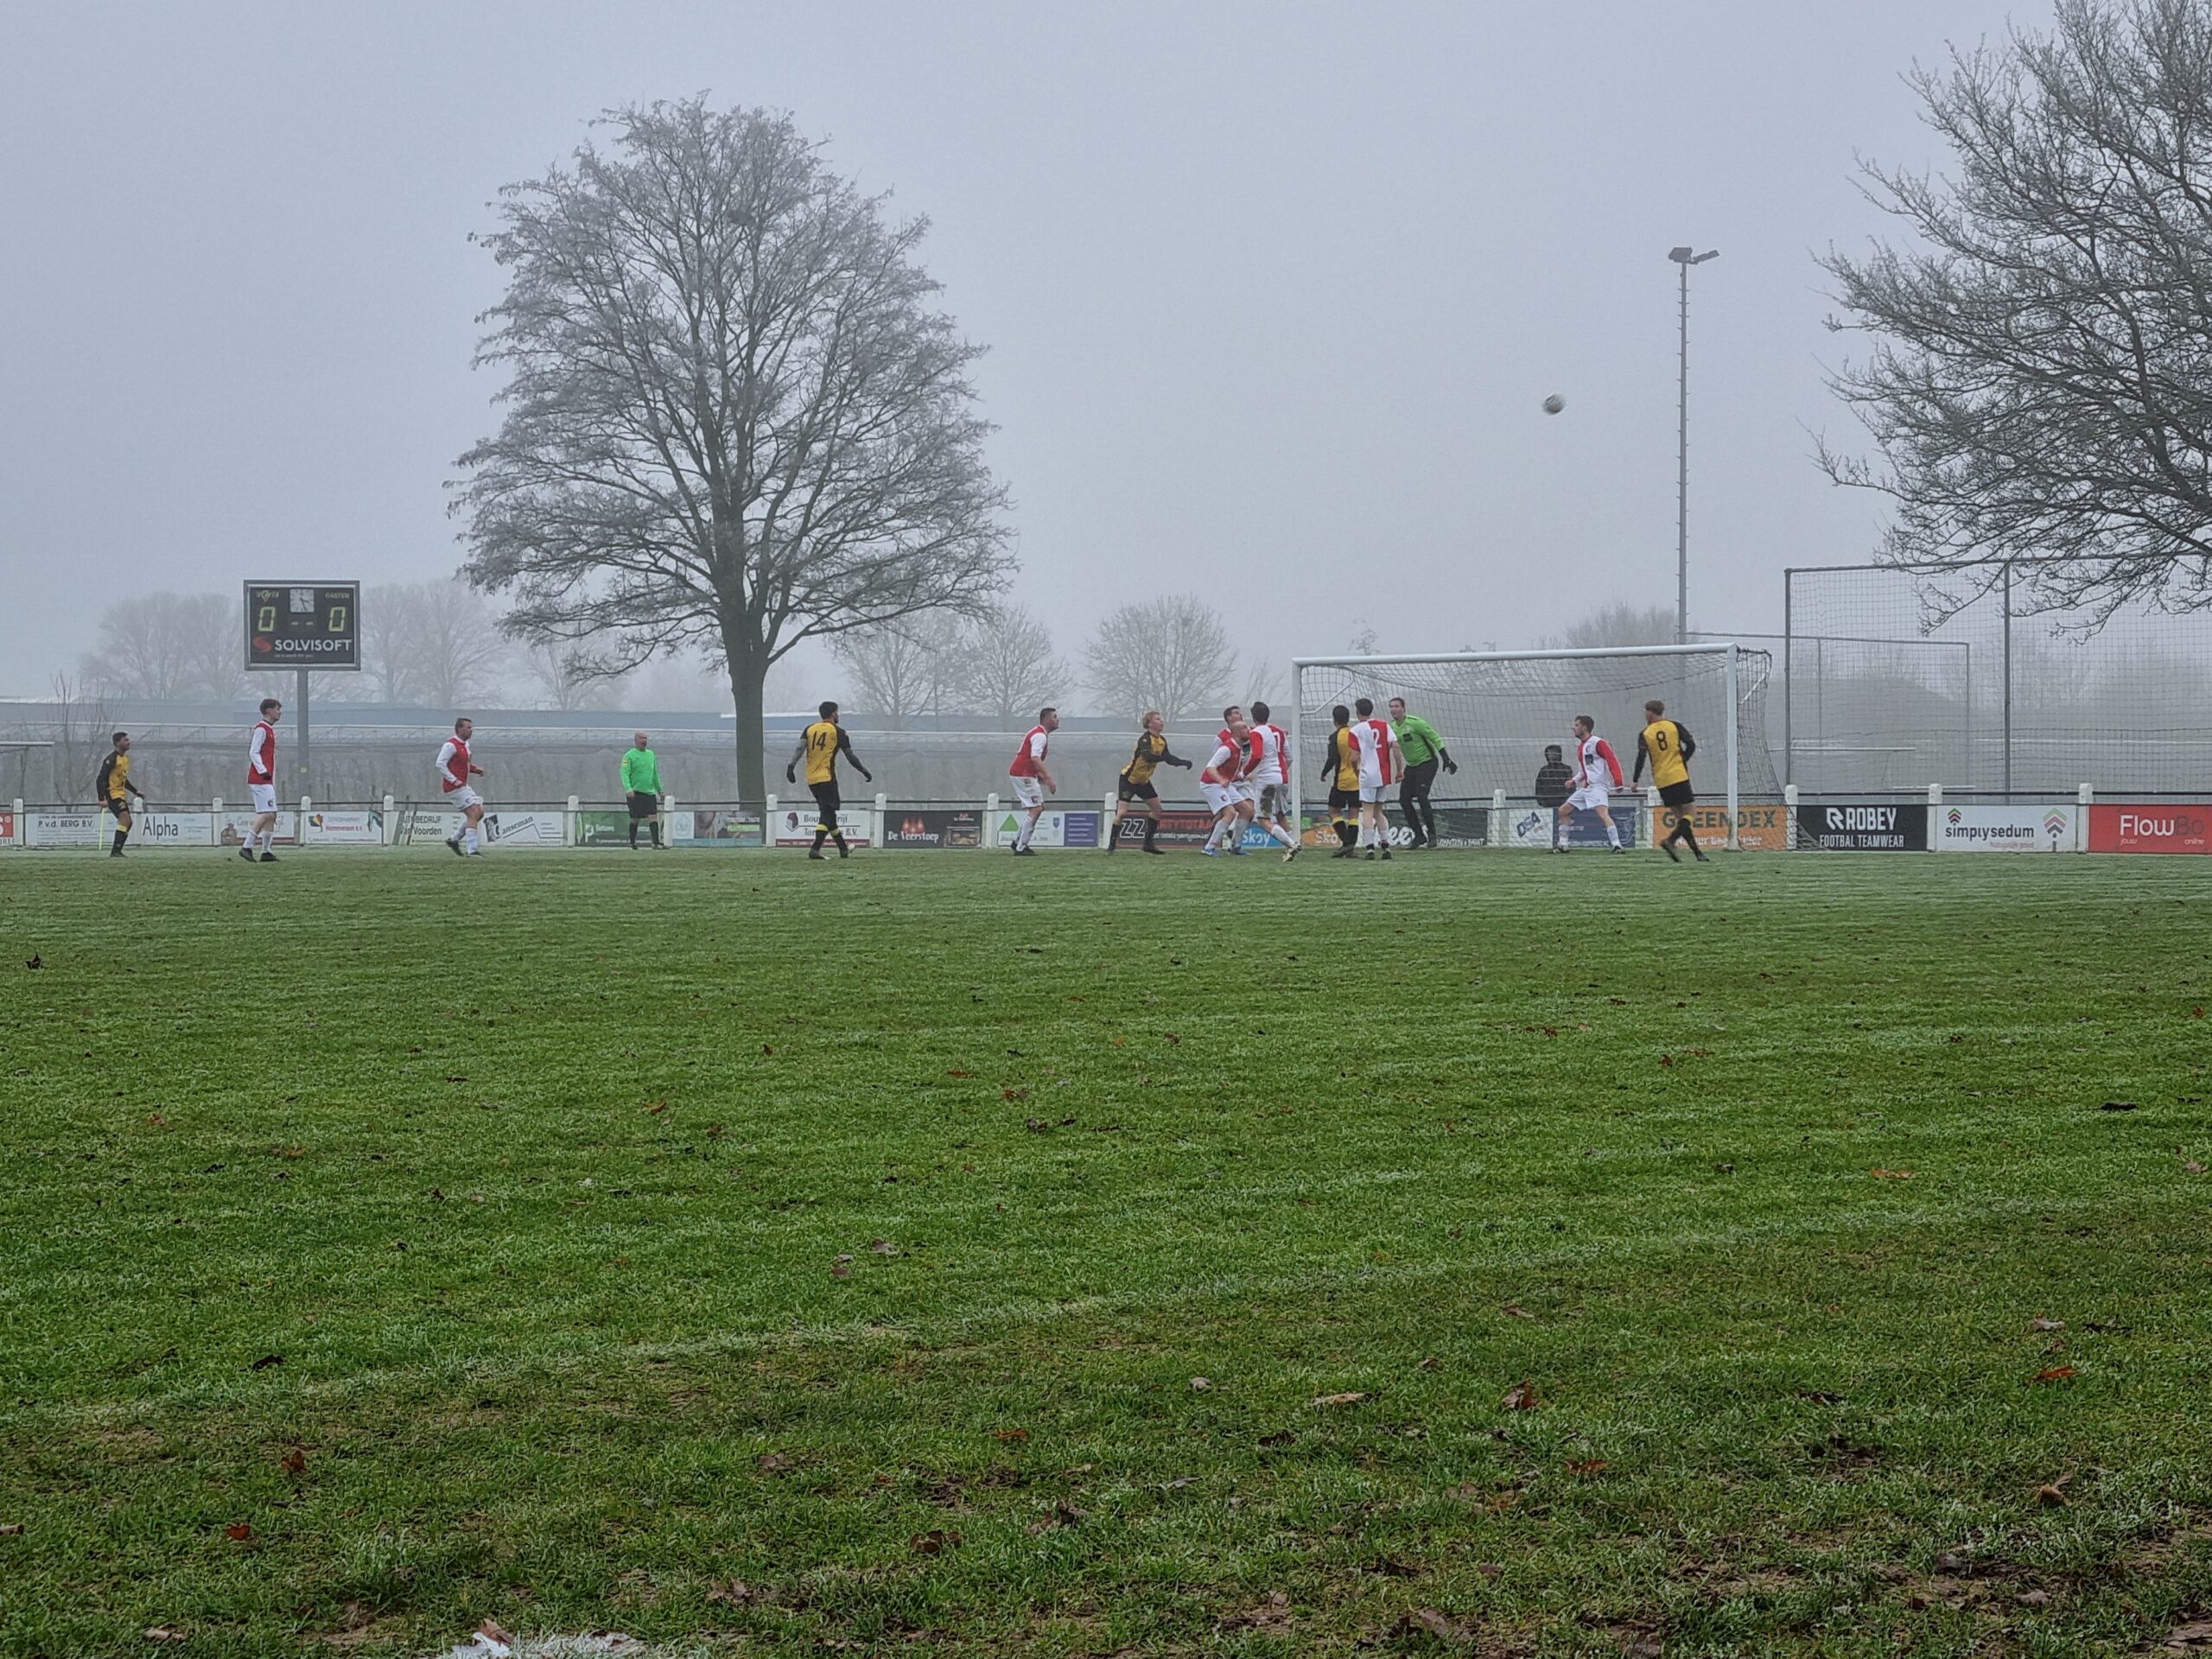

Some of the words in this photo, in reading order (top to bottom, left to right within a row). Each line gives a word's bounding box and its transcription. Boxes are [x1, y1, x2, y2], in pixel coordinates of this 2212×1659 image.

[258, 607, 276, 632] 0
[328, 607, 346, 632] 0
[275, 639, 352, 652] SOLVISOFT
[812, 730, 827, 751] 14
[1371, 728, 1382, 748] 2
[1656, 731, 1668, 751] 8
[60, 819, 79, 828] BERG
[143, 816, 178, 840] Alpha
[1662, 810, 1777, 828] GEENDEX
[1846, 807, 1897, 830] ROBEY
[414, 826, 442, 836] Voorden
[887, 830, 898, 841] De
[900, 830, 939, 843] Veerstoep
[1820, 835, 1855, 848] FOOTBAL
[1859, 835, 1904, 848] TEAMWEAR
